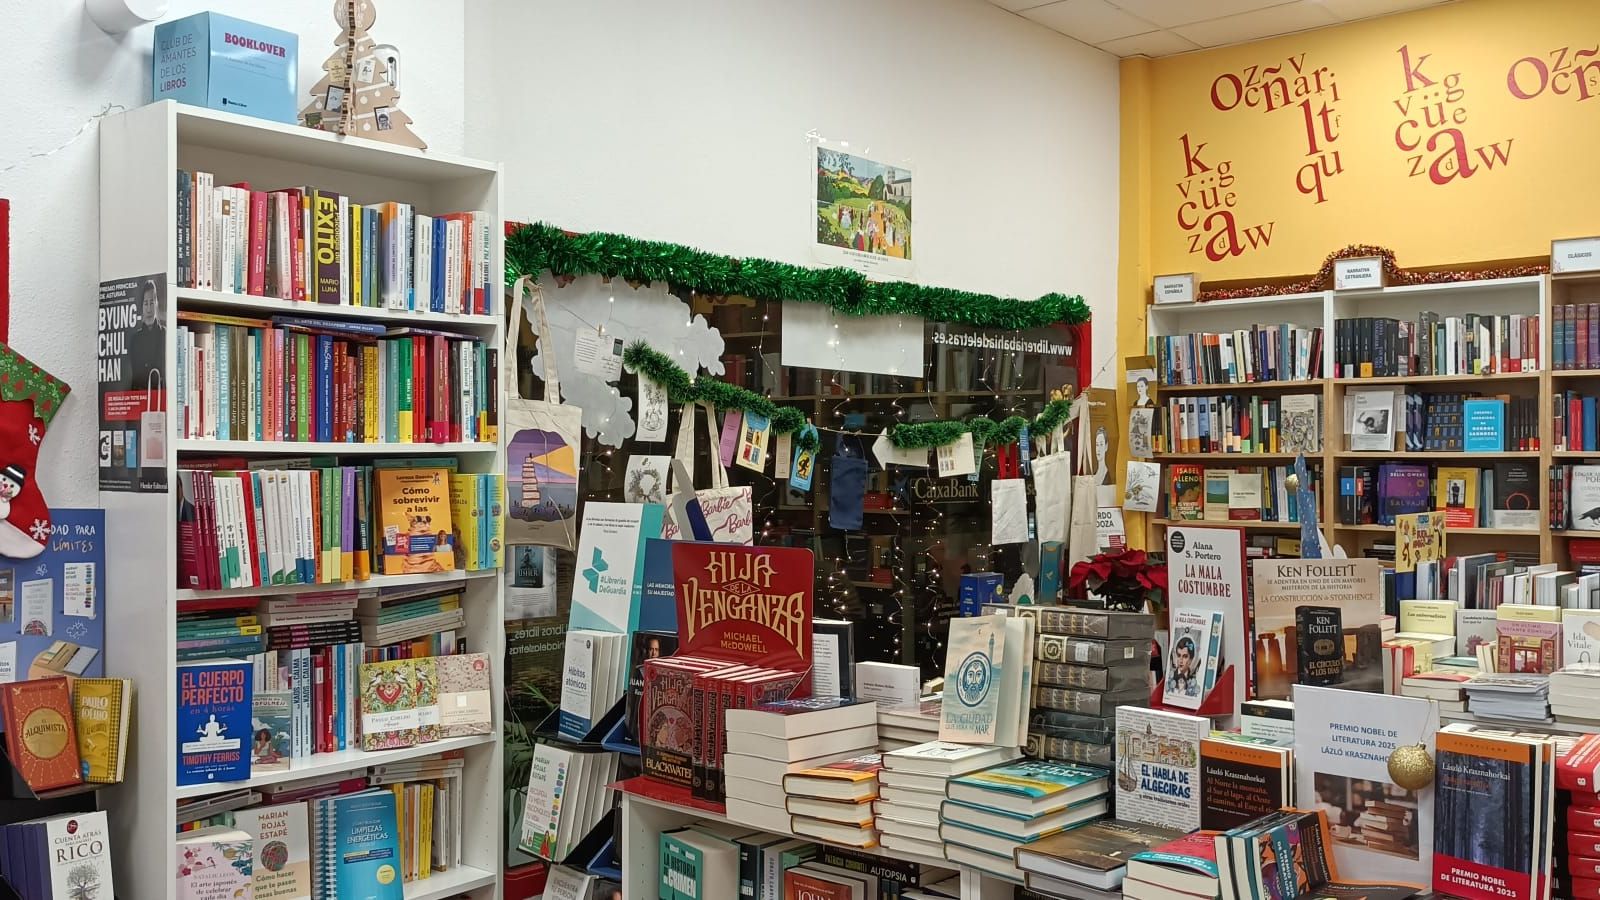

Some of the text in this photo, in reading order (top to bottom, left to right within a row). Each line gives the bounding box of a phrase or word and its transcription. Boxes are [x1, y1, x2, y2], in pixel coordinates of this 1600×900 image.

[183, 33, 193, 46] DE
[224, 32, 286, 58] BOOKLOVER
[161, 46, 197, 63] AMANTES
[160, 63, 187, 79] DE LOS
[160, 77, 187, 92] LIBROS
[317, 196, 338, 265] ÉXITO
[1568, 251, 1592, 259] CLÁSICOS
[320, 278, 339, 286] MARIO
[321, 286, 338, 294] LUNA
[99, 304, 142, 331] BYUNG-
[98, 331, 128, 357] CHUL
[98, 358, 121, 382] HAN
[1176, 467, 1199, 475] ISABEL
[1172, 475, 1203, 483] ALLENDE
[402, 486, 430, 495] Cómo
[914, 477, 979, 500] CaixaBank
[393, 496, 440, 505] sobrevivir
[414, 505, 428, 513] las
[75, 524, 96, 536] PARA
[53, 539, 94, 553] LÍMITES
[1192, 540, 1213, 551] Alana
[1185, 550, 1222, 562] S. Portero
[703, 551, 779, 588] HIJA
[1184, 563, 1223, 581] LA MALA
[1277, 563, 1357, 578] KEN FOLLETT
[599, 585, 627, 596] DeGuardia
[730, 583, 752, 594] DE LA
[1178, 579, 1232, 598] COSTUMBRE
[1261, 595, 1269, 603] LA
[1270, 593, 1324, 603] CONSTRUCCIÓN
[682, 577, 805, 661] VENGANZA
[1308, 617, 1339, 635] KEN FOLLETT
[723, 631, 763, 644] MICHAEL
[1573, 632, 1586, 641] Ida
[720, 640, 769, 654] McDOWELL
[1567, 640, 1592, 650] Vitale
[1309, 661, 1316, 669] EL
[1315, 668, 1327, 677] LOS
[182, 670, 244, 689] EL CUERPO
[81, 696, 109, 708] PAULO
[181, 686, 244, 706] PERFECTO
[959, 713, 993, 724] CIUDAD
[25, 723, 67, 739] ALQUIMISTA
[1329, 722, 1398, 738] PREMIO NOBEL DE
[1331, 735, 1397, 750] LITERATURA 2025
[183, 753, 212, 766] TIMOTHY
[1320, 745, 1390, 763] LÁZLÓ KRASZNAHO
[1141, 763, 1189, 785] EL HABLA DE
[1442, 762, 1511, 781] László Krasznahorkai
[1140, 777, 1191, 799] ALGECIRAS
[258, 810, 289, 821] MARIAN
[261, 820, 286, 831] ROJAS
[351, 824, 383, 835] LIMPIEZAS
[54, 833, 81, 845] CUENTA
[260, 828, 288, 840] ESTAPÉ
[346, 832, 389, 844] ENERGÉTICAS
[56, 840, 104, 863] RICO
[671, 859, 697, 879] HISTORIA
[870, 865, 907, 883] AUTOPSIA
[256, 870, 295, 882] Cómo hacer
[1451, 867, 1507, 887] PREMIO NOBEL
[255, 884, 267, 892] que
[277, 879, 297, 889] pasen
[668, 868, 697, 898] CRIMEN
[1440, 873, 1517, 898] DE LITERATURA 2025
[254, 887, 297, 900] cosas buenas
